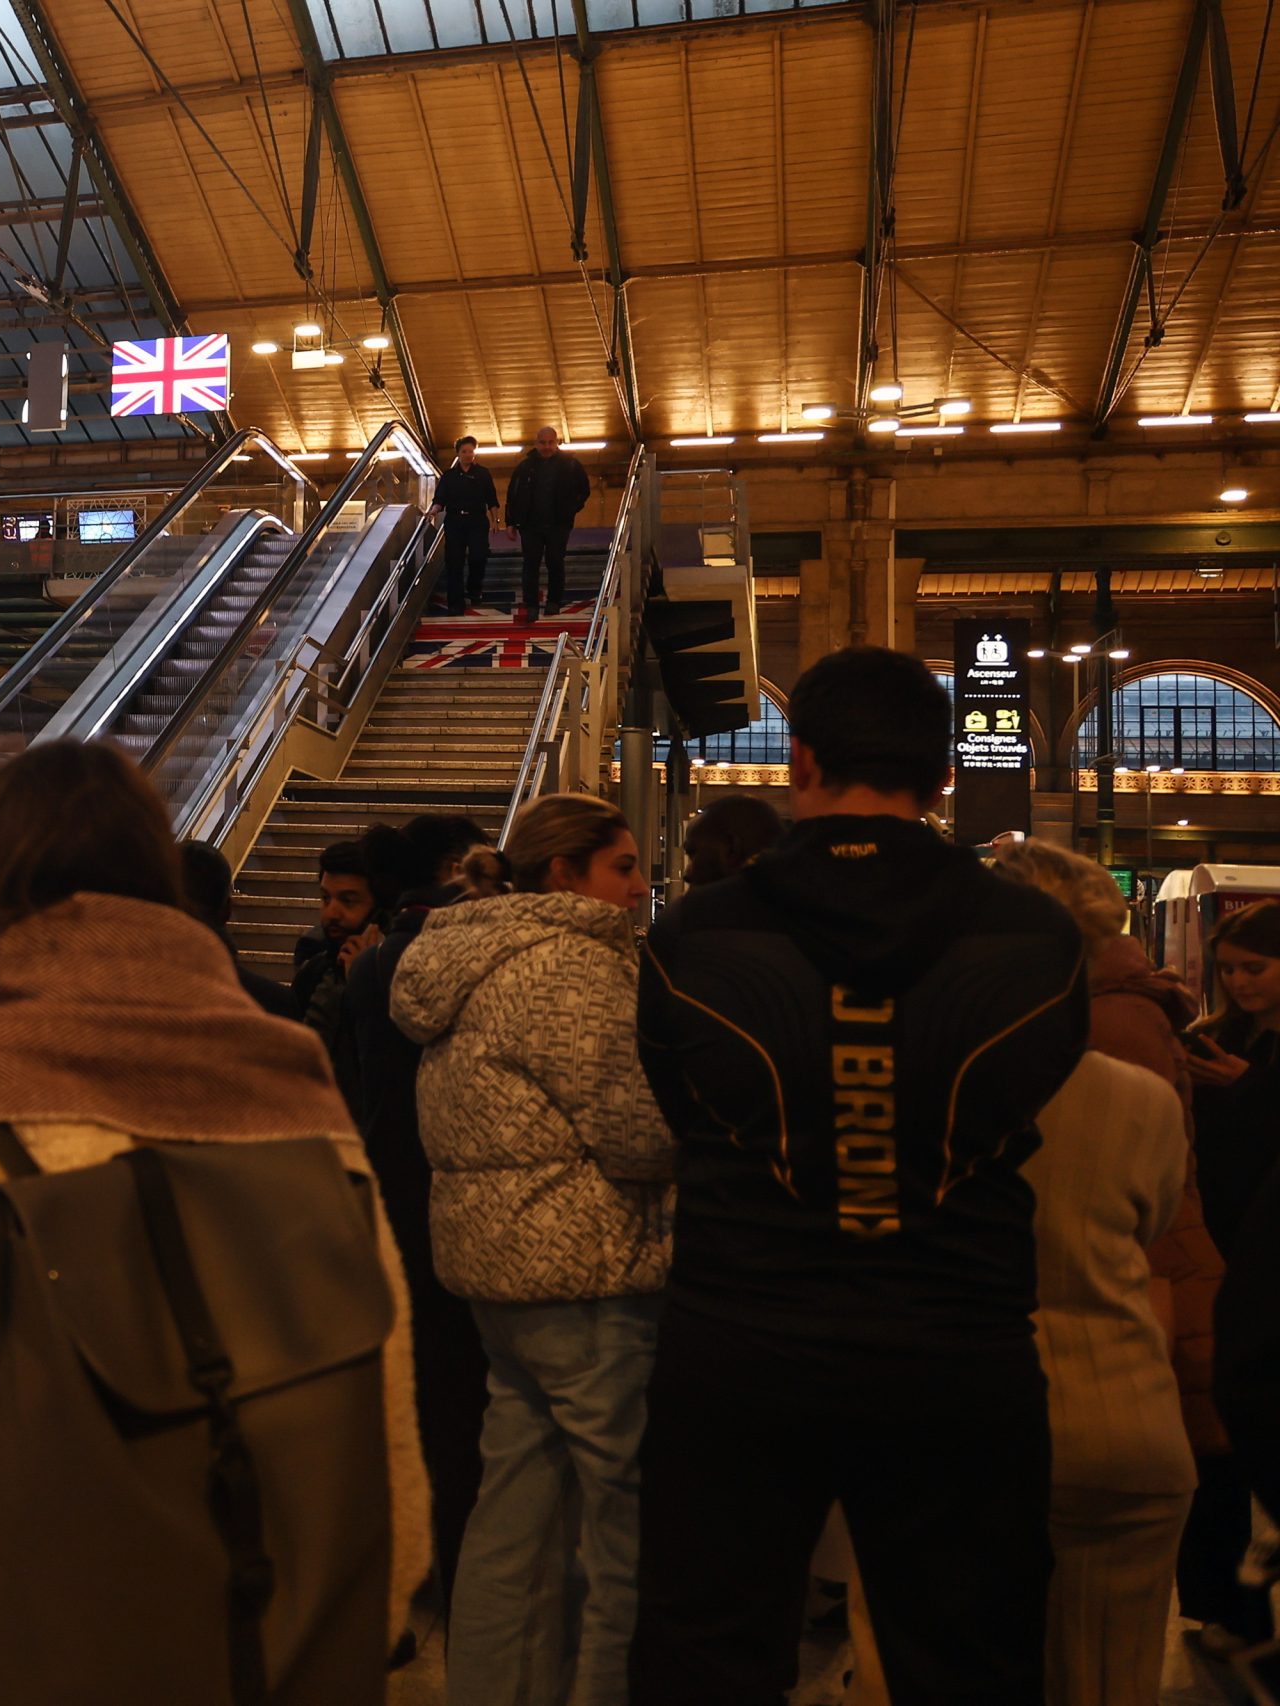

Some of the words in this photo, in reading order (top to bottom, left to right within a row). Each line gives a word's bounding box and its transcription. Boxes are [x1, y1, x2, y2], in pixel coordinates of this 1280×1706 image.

[967, 669, 1017, 678] Ascenseur
[967, 733, 1017, 745] Consignes
[957, 742, 990, 754] Objets
[990, 744, 1028, 753] trouvés
[831, 841, 879, 858] VENUM
